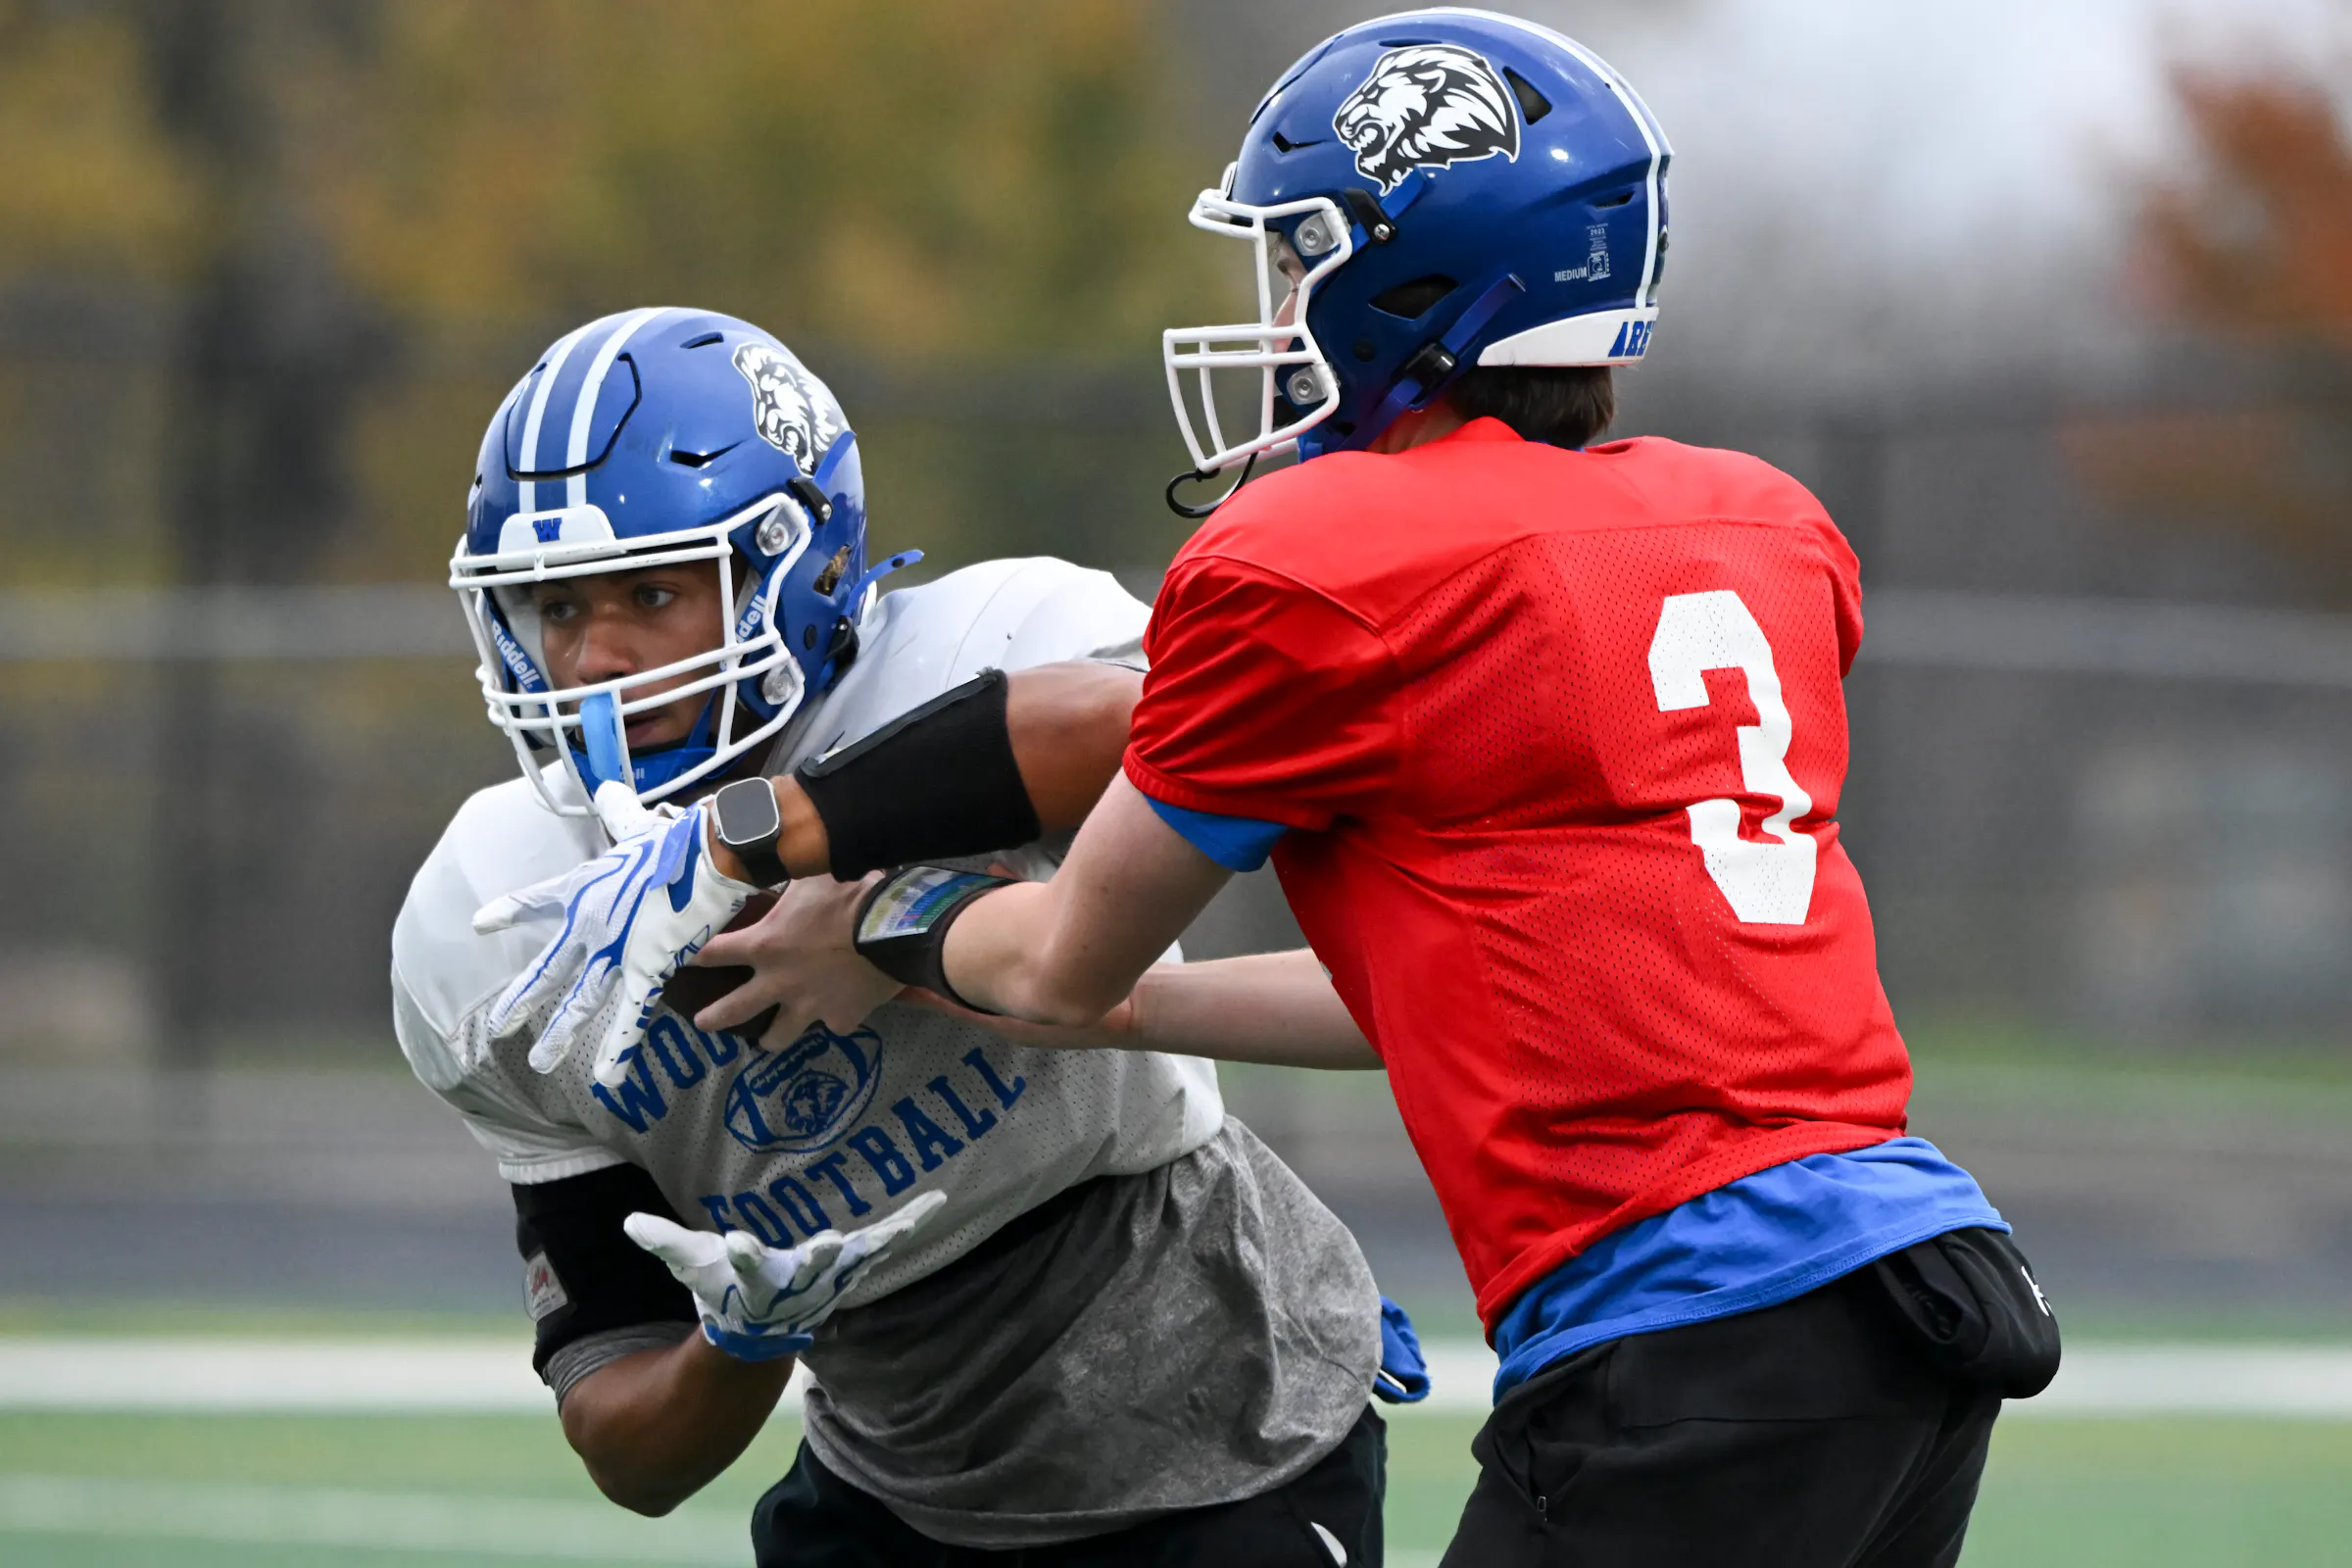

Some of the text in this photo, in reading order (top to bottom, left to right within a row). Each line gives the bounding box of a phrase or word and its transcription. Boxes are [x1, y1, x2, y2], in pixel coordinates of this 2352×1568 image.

[1554, 267, 1588, 282] MEDIUM
[532, 516, 563, 544] W
[492, 618, 541, 686] Riddell
[1647, 589, 1818, 925] 3
[699, 1047, 1027, 1250] FOOTBALL
